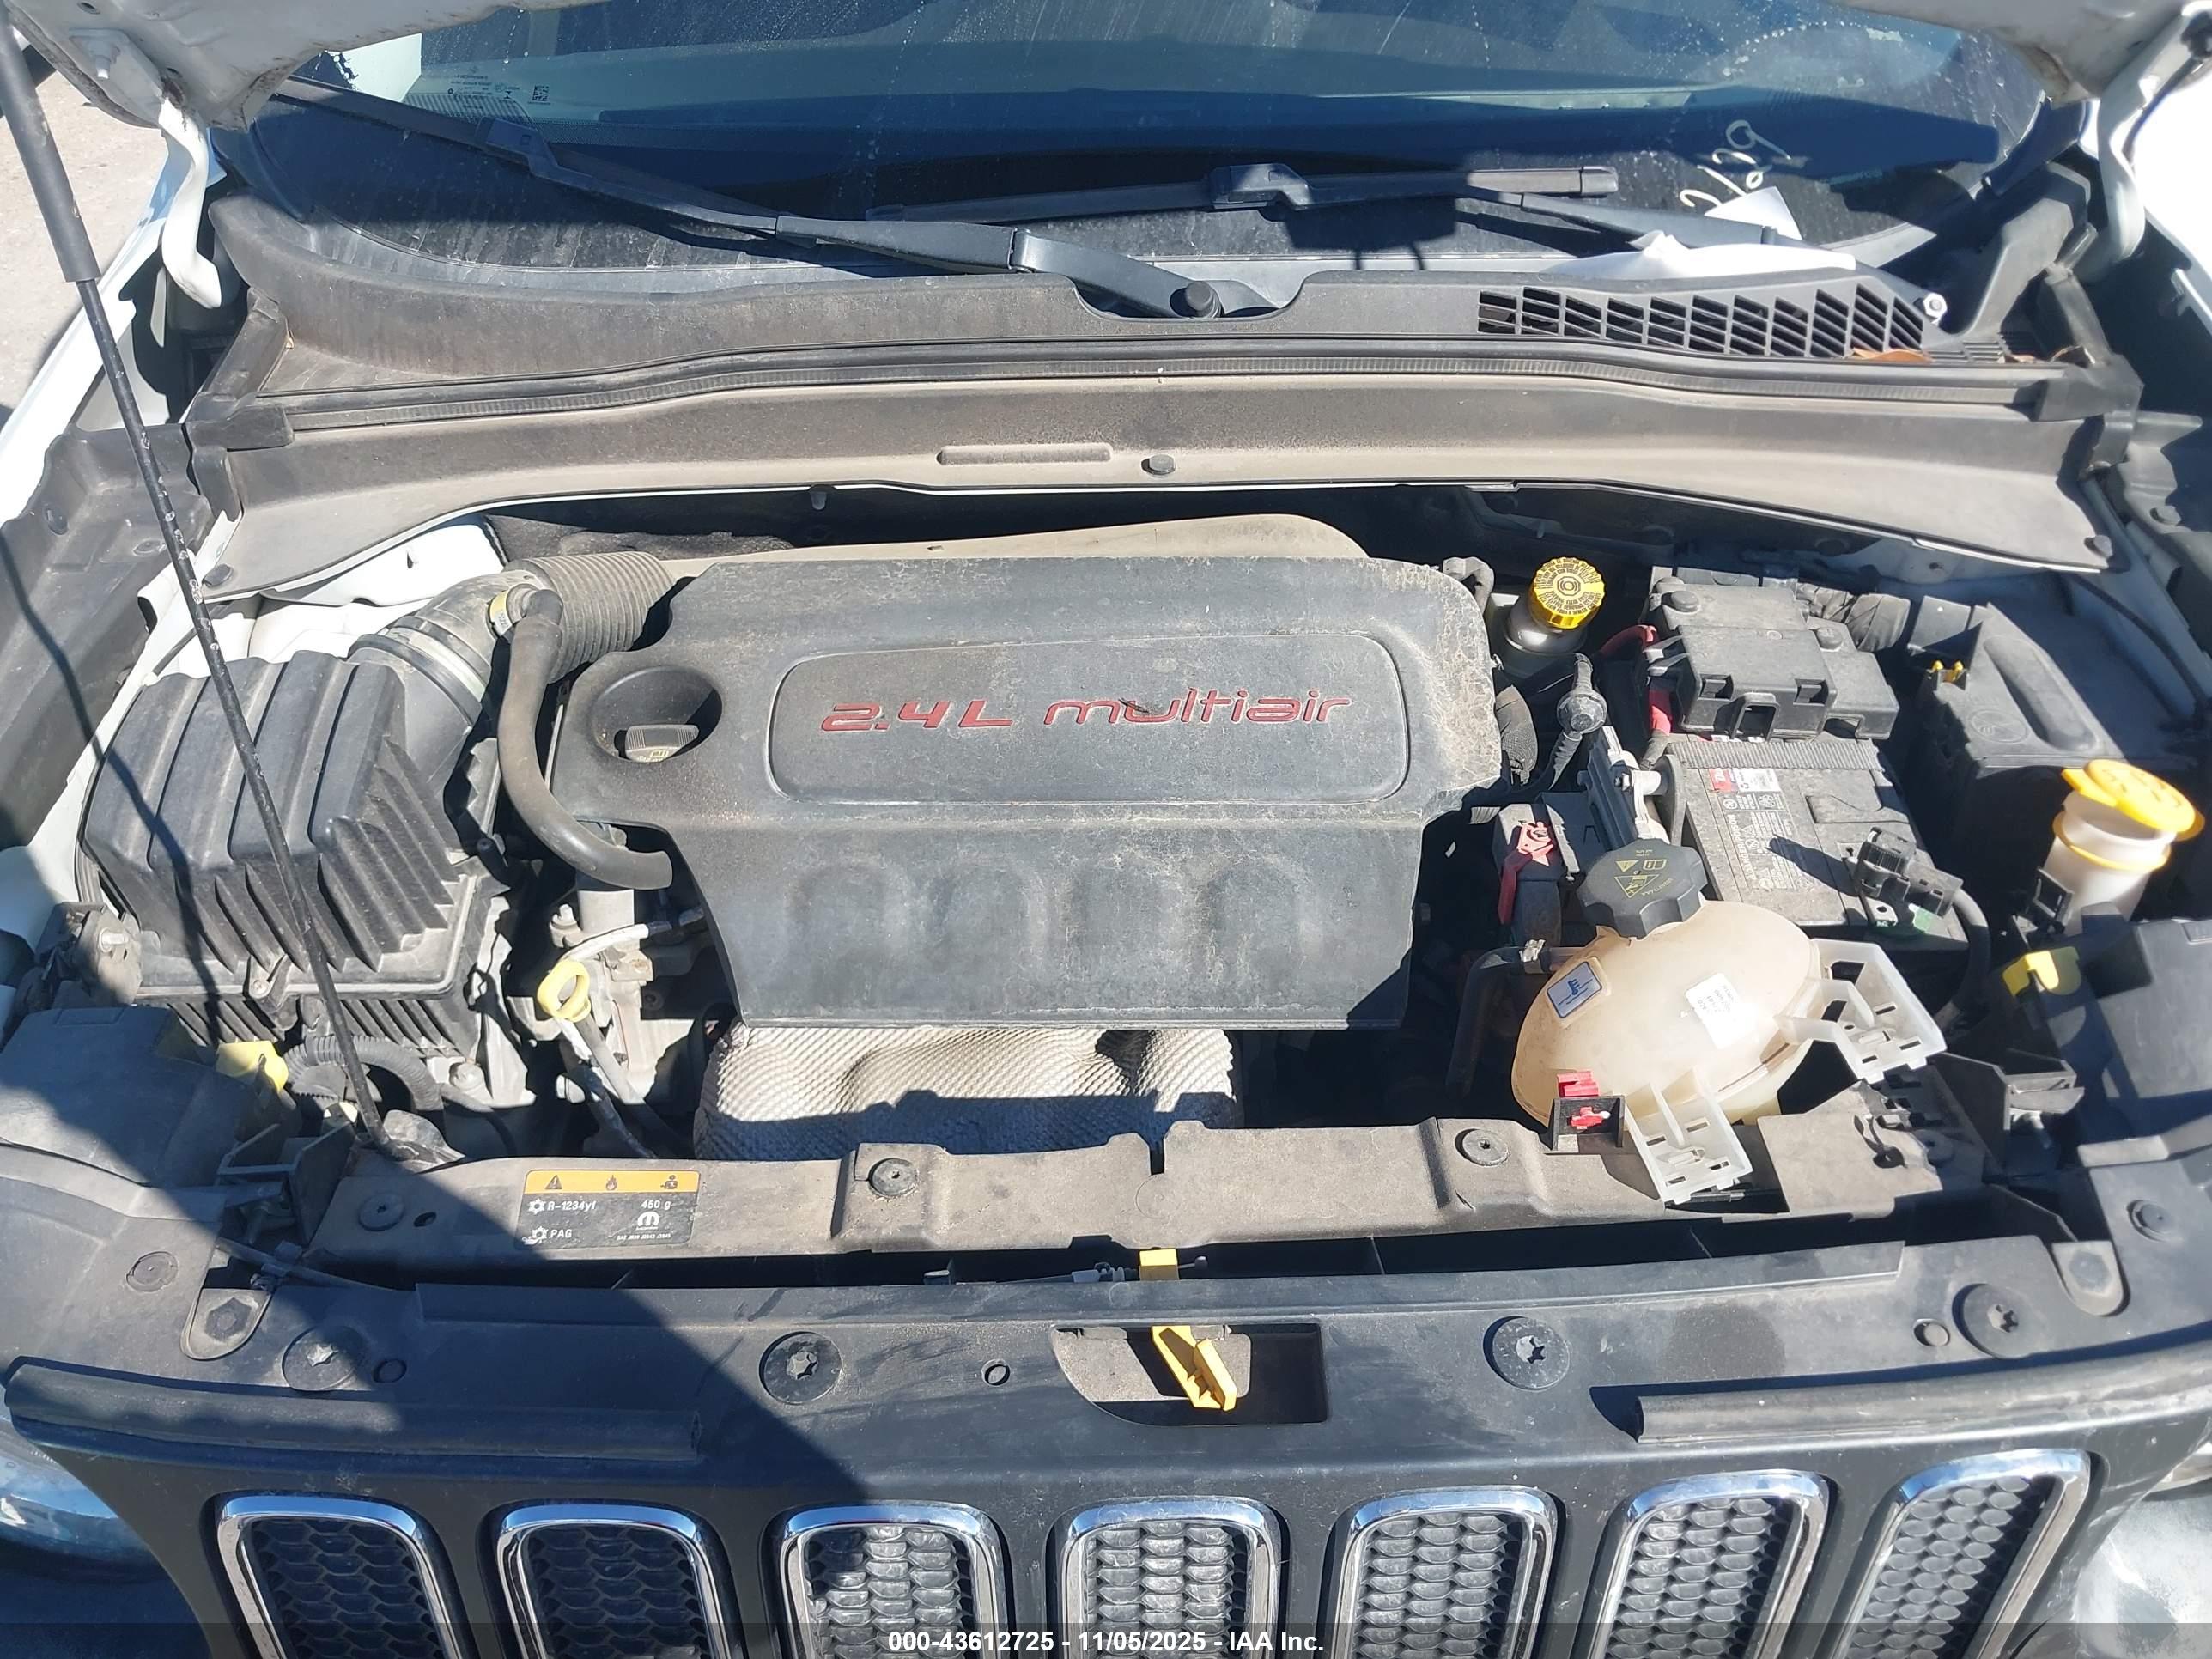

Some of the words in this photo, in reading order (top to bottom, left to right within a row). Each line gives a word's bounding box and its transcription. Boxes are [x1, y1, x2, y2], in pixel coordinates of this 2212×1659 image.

[1043, 690, 1352, 726] multiair
[547, 1200, 596, 1212] R-1234yf
[550, 1229, 573, 1238] PAG
